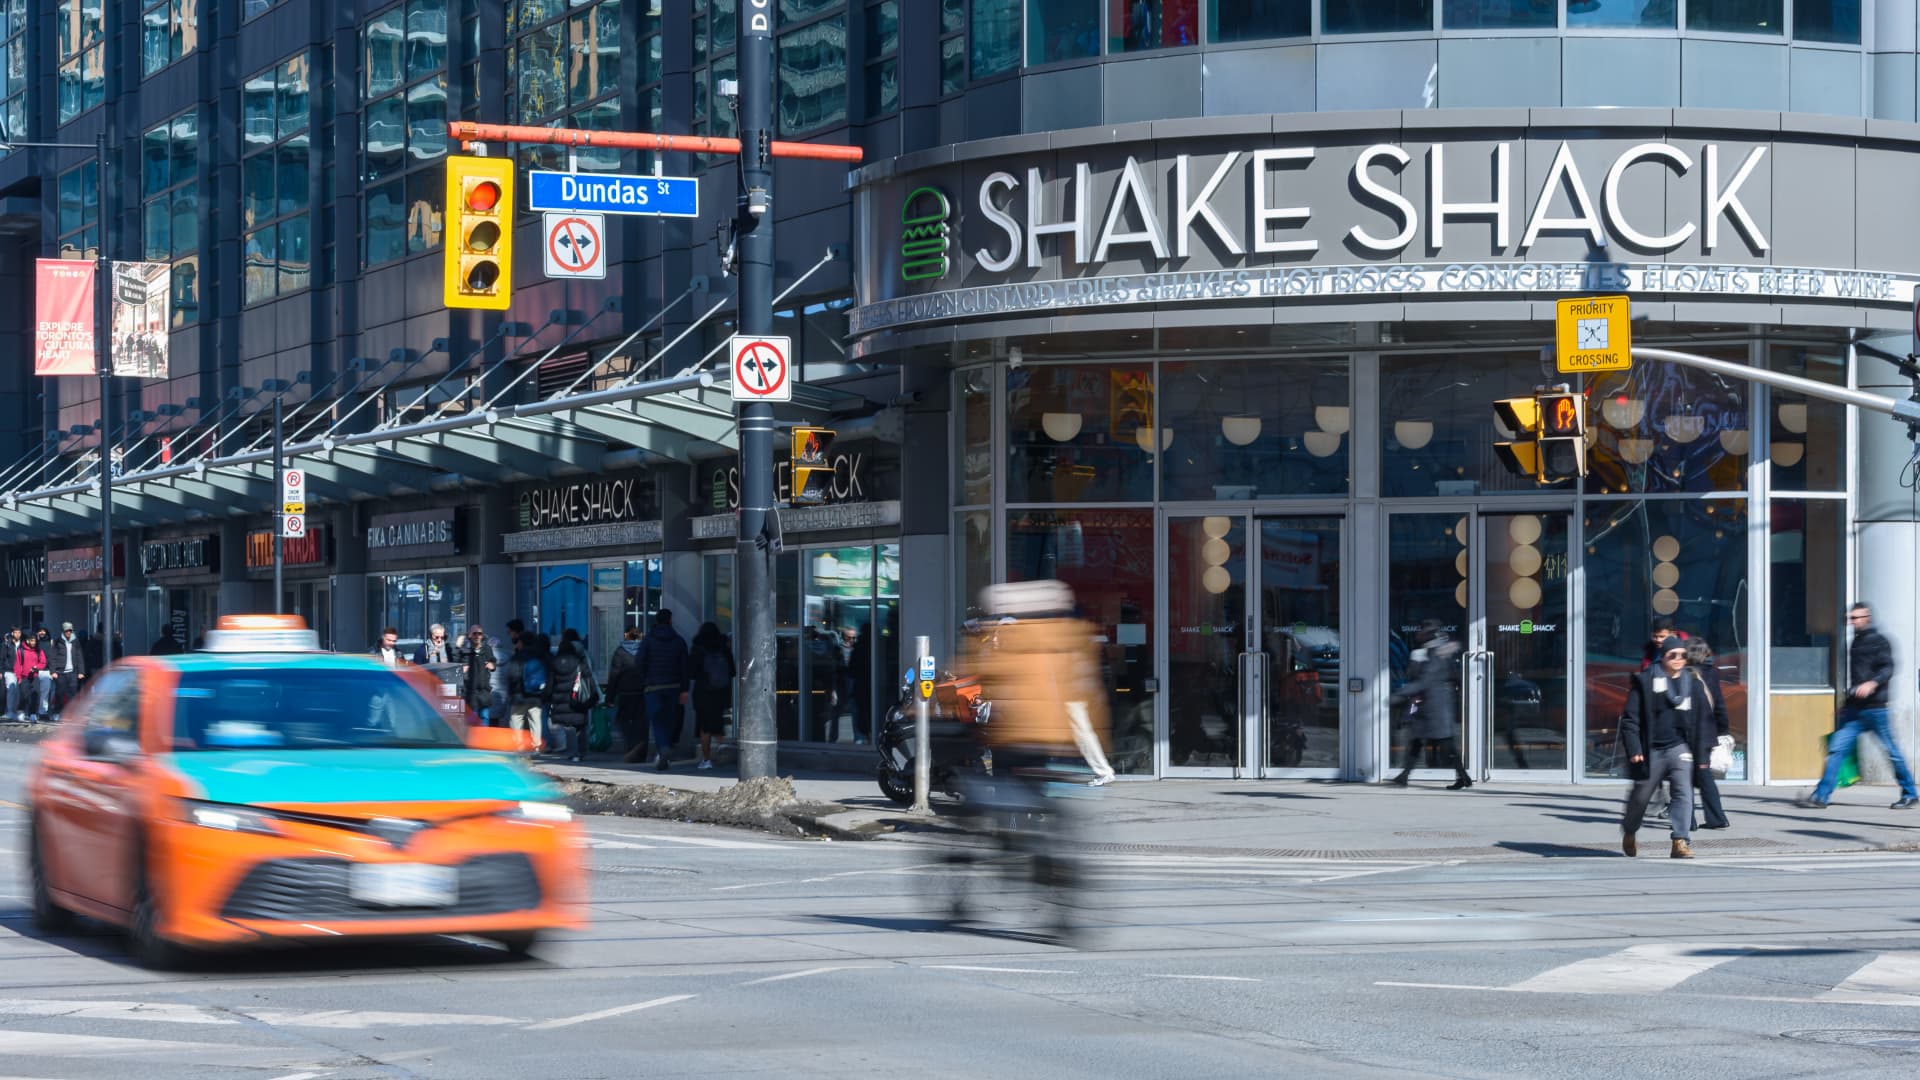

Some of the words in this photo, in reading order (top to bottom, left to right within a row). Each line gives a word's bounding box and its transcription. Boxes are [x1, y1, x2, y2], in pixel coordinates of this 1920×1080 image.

[561, 176, 649, 205] Dundas
[657, 181, 670, 195] St
[974, 146, 1319, 273] SHAKE
[1350, 139, 1769, 252] SHACK
[962, 284, 1054, 314] CUSTARD
[1065, 277, 1129, 303] FRIES
[1143, 270, 1250, 299] SHAKES
[1265, 267, 1329, 295] HOT
[1335, 264, 1426, 291] DOGS
[1442, 263, 1631, 290] CONCRETES
[1645, 264, 1750, 292] FLOATS
[1761, 268, 1826, 295] BEER
[1835, 271, 1897, 299] WINE
[1570, 303, 1614, 315] PRIORITY
[39, 321, 84, 331] EXPLORE
[36, 331, 93, 340] TORONTO'S
[38, 350, 71, 359] HEART
[1569, 353, 1619, 366] CROSSING
[531, 485, 579, 526] SHAKE
[581, 478, 635, 522] SHACK
[367, 527, 386, 548] FIKA
[388, 520, 447, 546] CANNABIS
[246, 532, 275, 567] LITTLE
[283, 527, 318, 565] ANADA
[72, 558, 95, 571] MEXICAN
[1180, 625, 1201, 633] SHAKE
[1212, 625, 1233, 633] SHACK
[1499, 624, 1520, 632] SHAKE
[1532, 624, 1555, 632] SHACK
